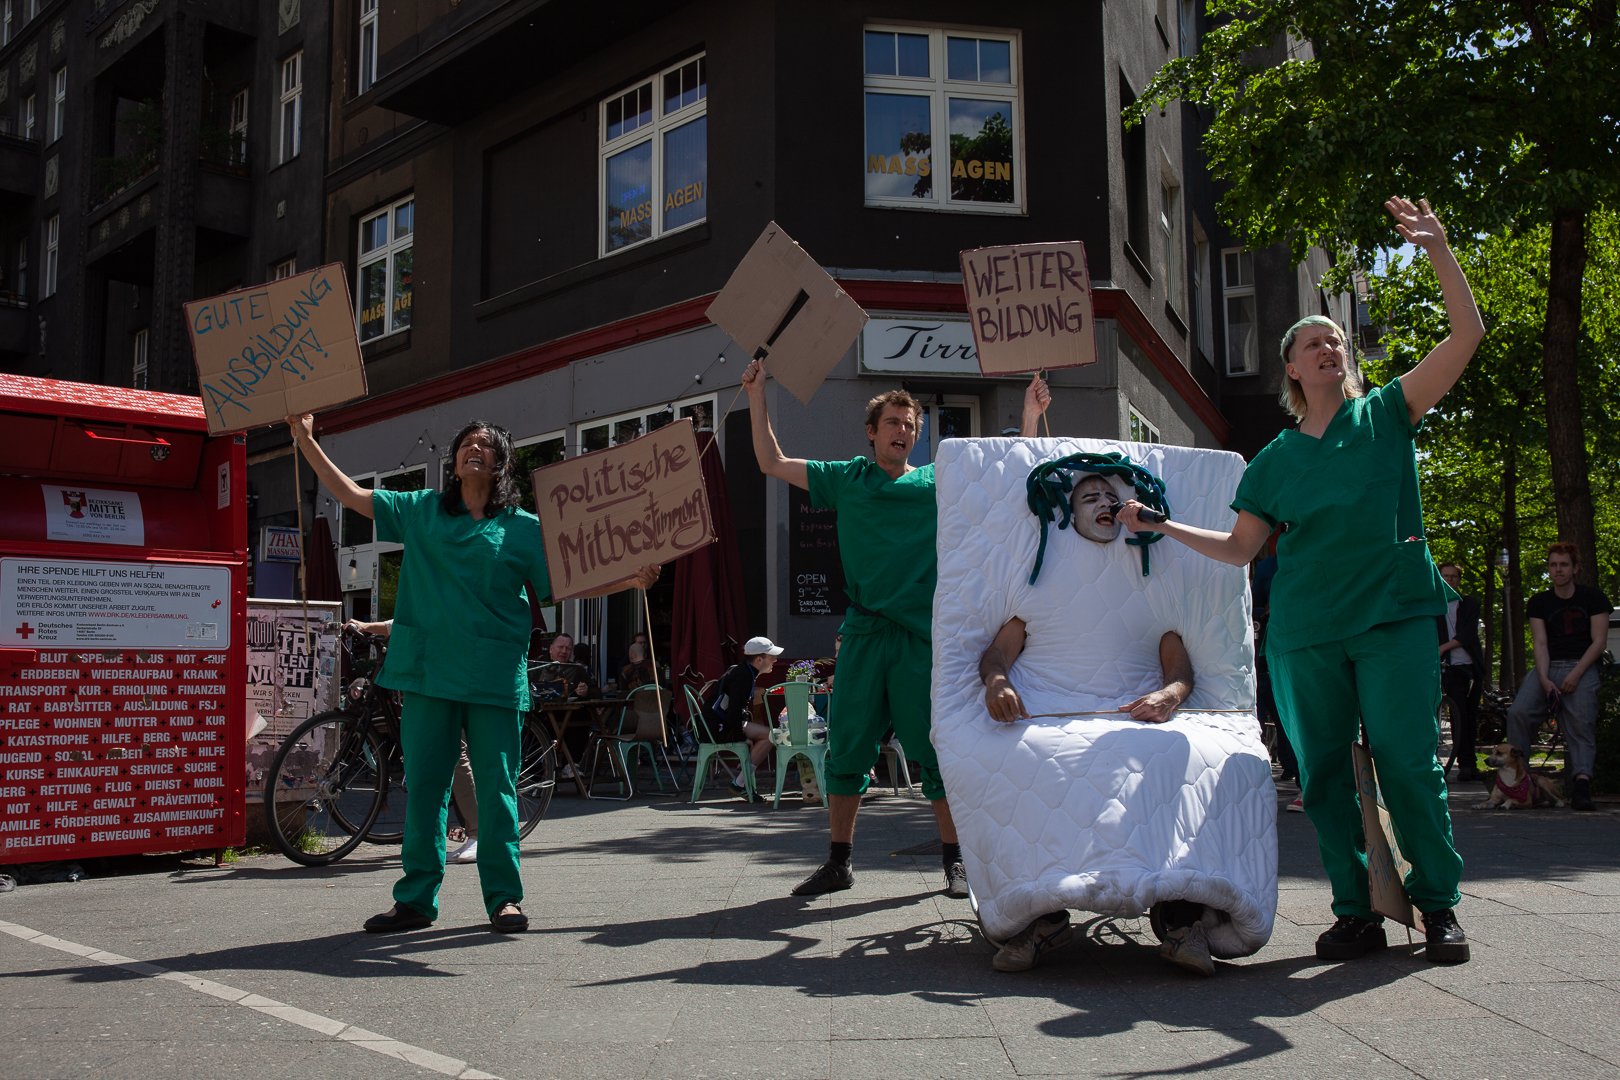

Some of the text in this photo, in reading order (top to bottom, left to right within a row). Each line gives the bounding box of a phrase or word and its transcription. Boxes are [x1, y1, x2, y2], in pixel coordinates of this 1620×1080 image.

[867, 154, 1011, 181] MASS AGEN
[620, 202, 652, 229] MASS
[664, 181, 702, 213] AGEN
[194, 292, 269, 334] GUTE
[361, 303, 385, 325] MASS
[884, 323, 978, 360] Tirr
[89, 504, 125, 514] MITTE
[269, 532, 299, 548] THAI
[557, 488, 708, 588] Mitbestimmung
[267, 547, 300, 557] MASSAGEN
[17, 566, 165, 579] IHRE SPENDE HILFT UNS HELFEN!
[797, 574, 826, 584] OPEN
[165, 583, 211, 591] BENACHTEILIGTE
[277, 631, 309, 656] IR
[39, 653, 67, 663] BLUT
[136, 654, 164, 664] HUS
[176, 655, 196, 663] NOT
[20, 669, 218, 679] ERDBEBEN WIEDERAUFBAU KRANK
[0, 685, 226, 696] TRANSPORT KUR ERHOLUNG FINANZEN
[252, 689, 267, 697] WIR
[8, 701, 217, 712] RAT BABYSITTER AUSILDUNG FSJ
[53, 718, 102, 728] WOHNEN
[114, 717, 158, 727] MUTTER
[169, 716, 195, 726] KIND
[205, 716, 226, 725] KUR
[7, 731, 217, 746] KATASTROPHE HILFE BERG WACHE
[55, 751, 94, 762] SOAL
[105, 748, 143, 760] BEIT
[155, 747, 188, 758] ERSTE
[198, 747, 225, 756] HILFE
[6, 762, 217, 780] KURSE EINKAUFEN SERVICE SUCHE
[40, 784, 92, 795] RETTUNG
[104, 782, 132, 792] FLUG
[144, 779, 182, 790] DIENST
[193, 778, 225, 788] MOBIL
[6, 793, 215, 814] NOT HILFE GEWALT PRÄVENTION
[0, 808, 224, 832] AMILIE FÖRDERUNG ZUSAMMENKUNFT
[5, 825, 214, 848] BEGLEITUNG BEWEGUNG THERAPIE
